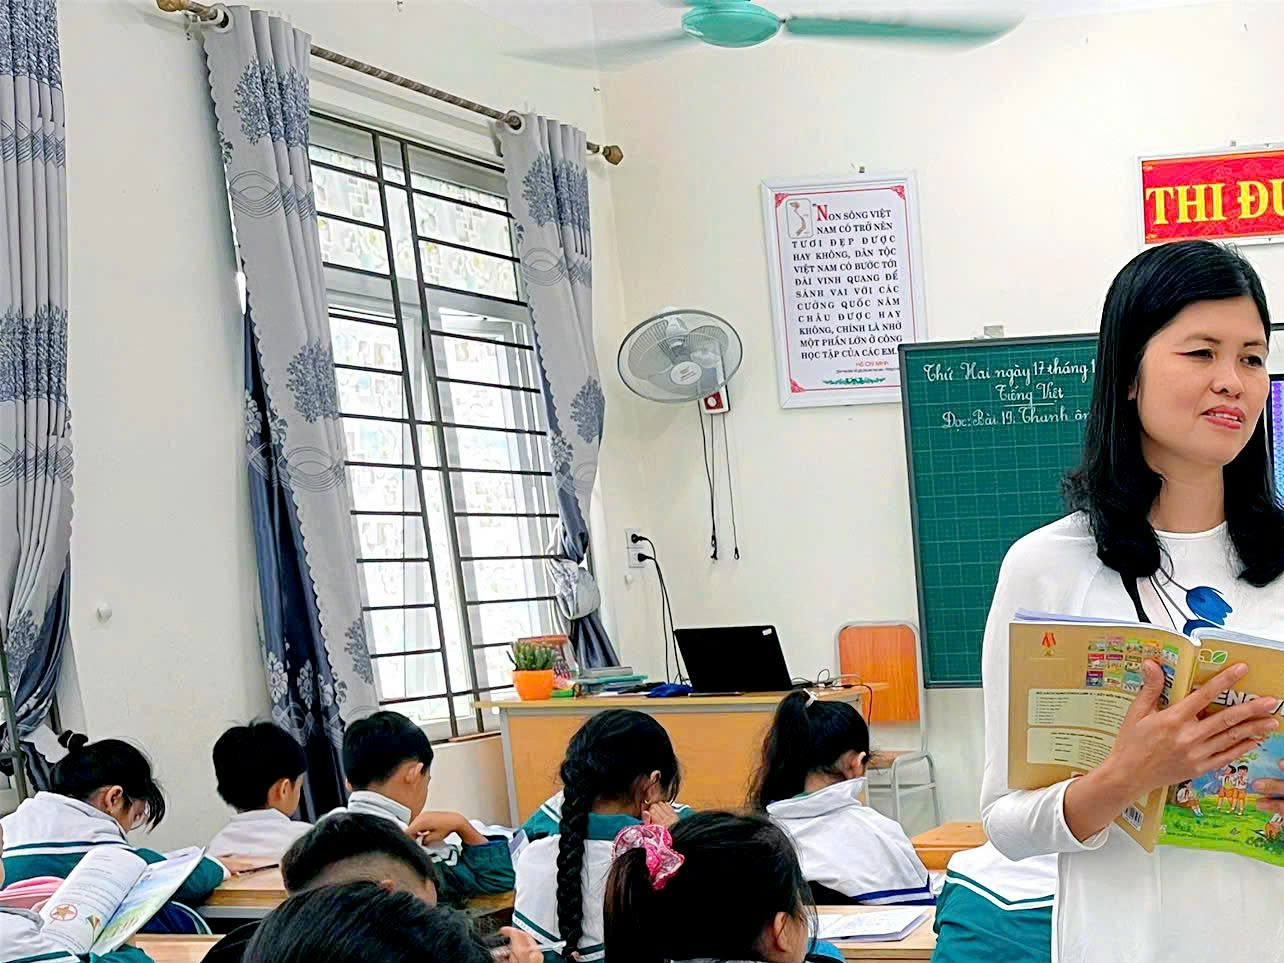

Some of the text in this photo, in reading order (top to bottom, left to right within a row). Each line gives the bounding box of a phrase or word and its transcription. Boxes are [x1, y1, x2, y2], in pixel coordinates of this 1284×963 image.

[1146, 184, 1227, 225] THI
[844, 210, 868, 220] SÔNG
[870, 208, 891, 218] VIỆT
[817, 226, 836, 234] NAM
[839, 224, 851, 232] CÓ
[793, 253, 810, 261] HAY
[879, 246, 896, 257] TỘC
[794, 264, 815, 274] VIỆT
[847, 274, 879, 284] QUANG
[879, 310, 900, 318] HAY
[800, 338, 819, 348] MỘT
[802, 352, 820, 360] HỌC
[822, 350, 839, 359] TẬP
[923, 364, 953, 381] Thứ
[960, 362, 990, 380] Hai
[995, 364, 1030, 386] ngày
[1033, 361, 1044, 375] 17
[1047, 357, 1088, 383] tháng
[995, 382, 1064, 408] Tiếng Việt
[1018, 405, 1068, 423] Thanh
